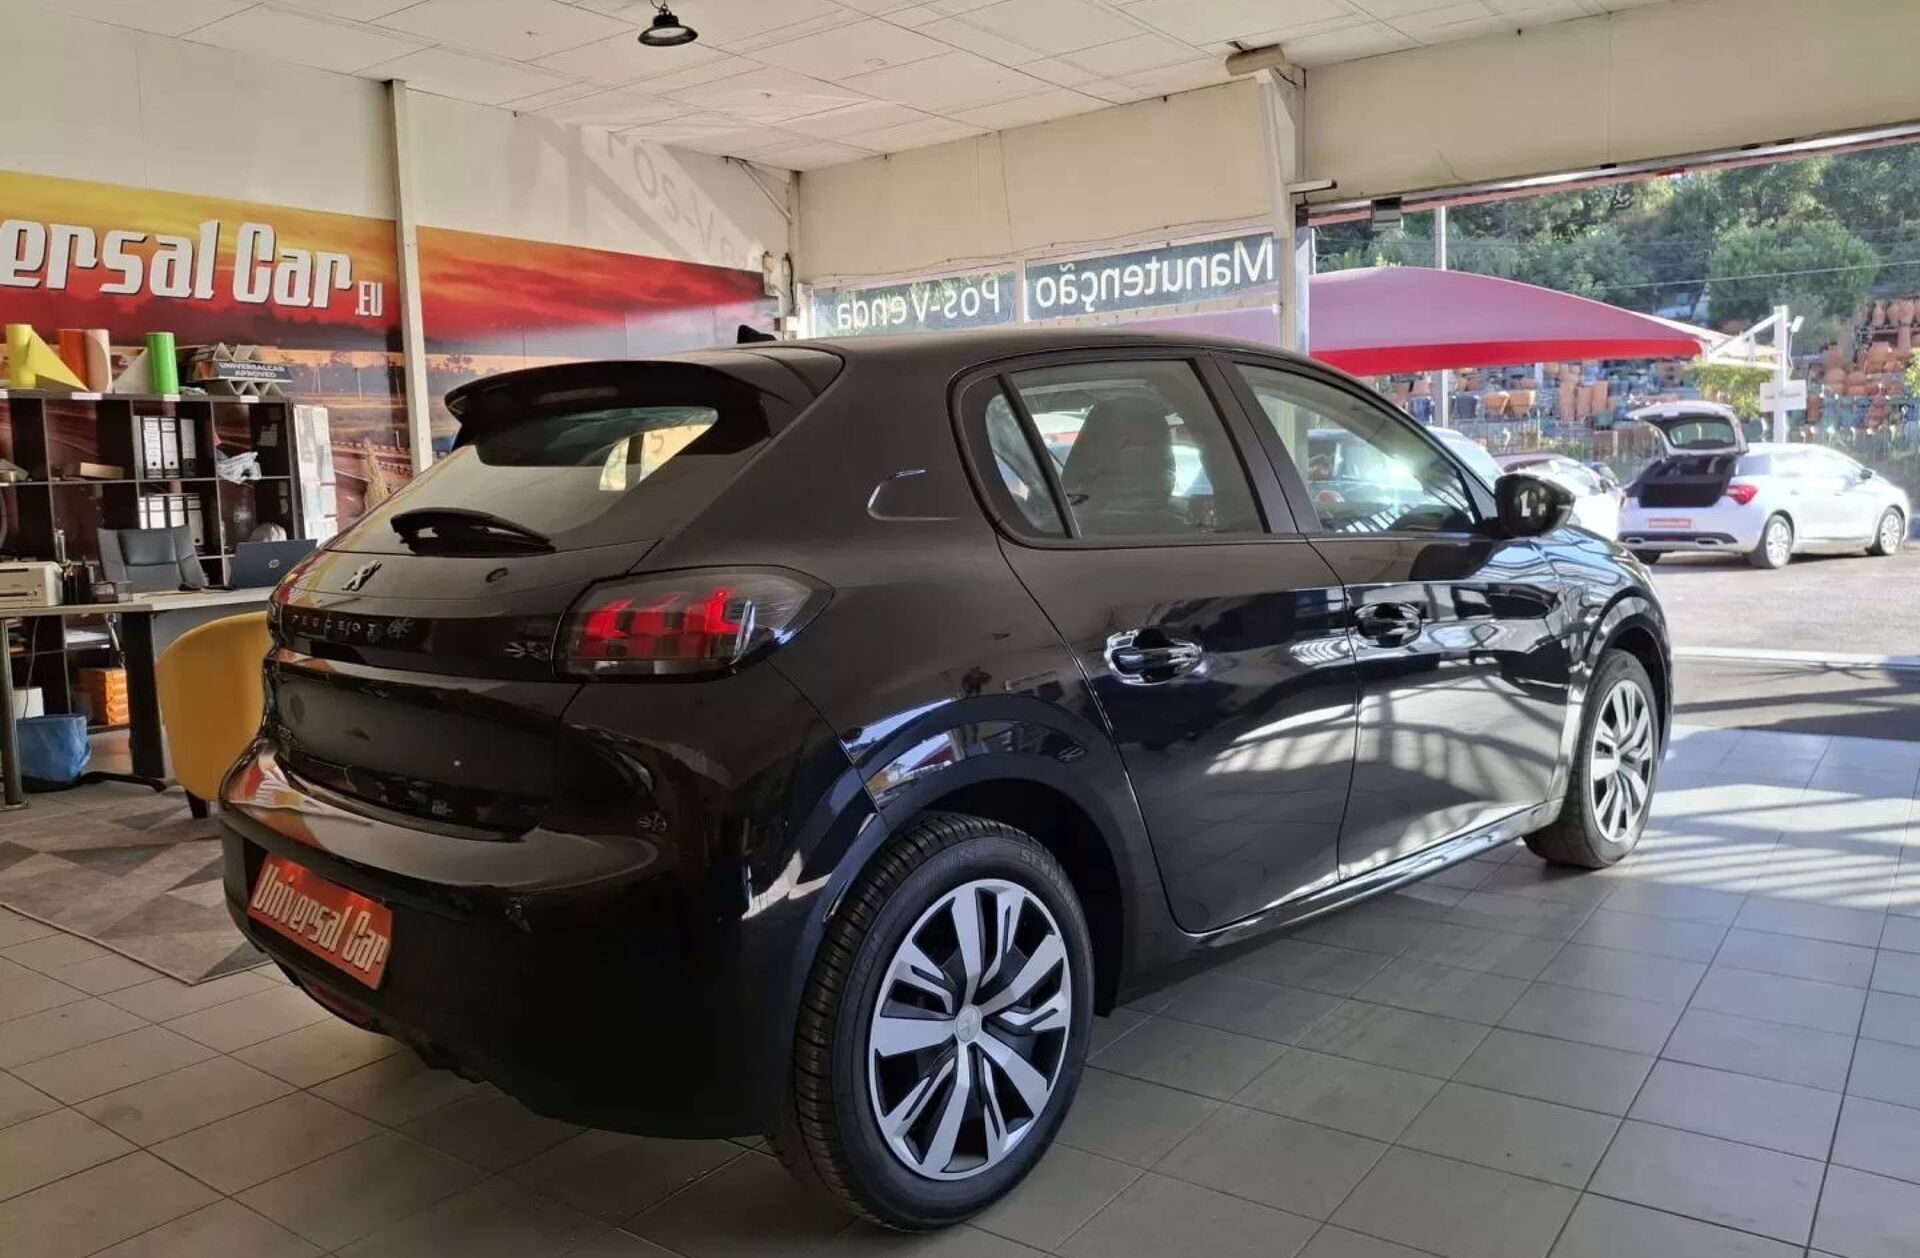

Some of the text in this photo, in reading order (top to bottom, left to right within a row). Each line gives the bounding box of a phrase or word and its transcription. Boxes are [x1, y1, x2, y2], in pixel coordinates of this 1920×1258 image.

[232, 221, 354, 309] Car
[253, 863, 388, 974] Universal Car
